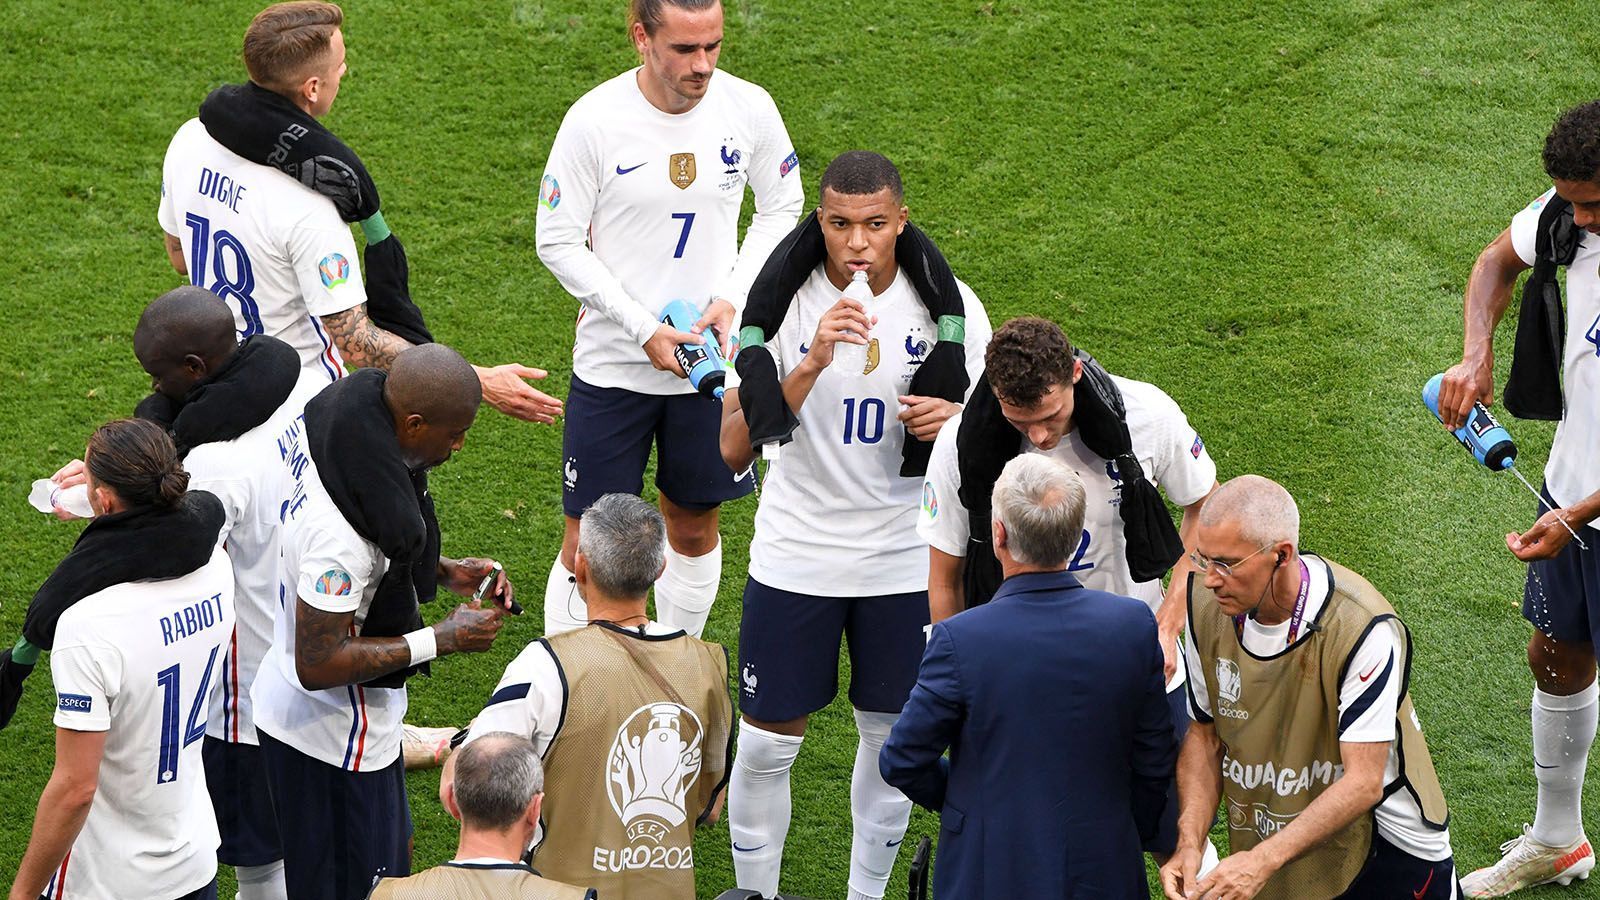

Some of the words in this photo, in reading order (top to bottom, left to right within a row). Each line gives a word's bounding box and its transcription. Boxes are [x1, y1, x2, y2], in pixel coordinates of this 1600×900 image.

[267, 123, 309, 168] EUR
[198, 167, 247, 214] DIGNE
[671, 212, 696, 259] 7
[185, 211, 264, 337] 18
[843, 397, 886, 445] 10
[1067, 528, 1095, 571] 2
[159, 592, 224, 647] RABIOT
[922, 624, 933, 645] 1
[59, 697, 91, 708] ESPECT
[157, 643, 221, 785] 14
[626, 823, 666, 841] UEFA
[593, 845, 694, 873] EURO202
